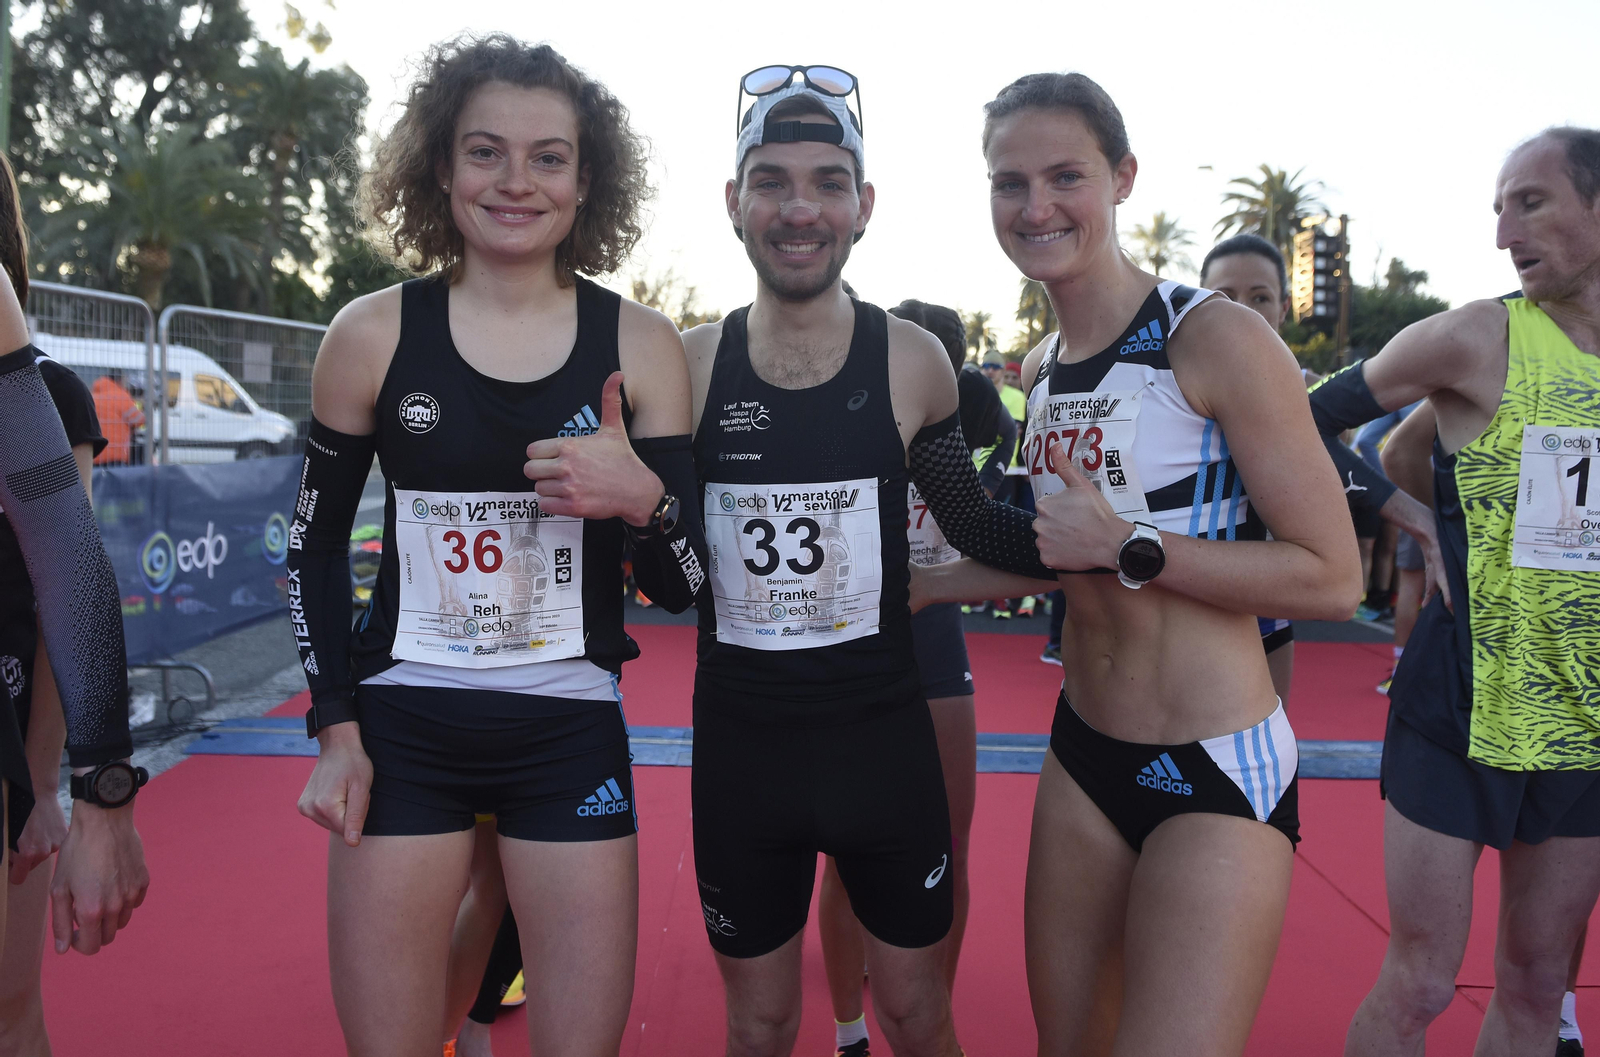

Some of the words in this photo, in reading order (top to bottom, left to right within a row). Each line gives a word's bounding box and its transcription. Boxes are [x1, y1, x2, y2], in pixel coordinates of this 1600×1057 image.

[1120, 338, 1164, 355] adidas
[1057, 397, 1109, 411] maratón
[720, 417, 750, 426] Marathon
[1069, 407, 1107, 420] sevilla
[724, 424, 752, 432] Hamburg
[1564, 435, 1591, 452] edp
[296, 456, 310, 512] MARATHON
[300, 490, 310, 518] TEAM
[737, 493, 767, 512] edp
[804, 499, 848, 511] sevilla
[788, 489, 848, 502] maratón
[306, 488, 319, 522] BERLIN
[431, 500, 460, 520] edp
[500, 508, 548, 520] sevilla
[176, 521, 228, 579] edp
[442, 529, 504, 574] 36
[670, 541, 682, 558] adidas
[742, 516, 825, 576] 33
[1562, 552, 1582, 560] HOKA
[678, 546, 706, 596] TERREX
[767, 578, 803, 586] Benjamin
[468, 592, 488, 600] Alina
[770, 588, 817, 600] Franke
[287, 566, 312, 652] TERREX
[474, 604, 500, 617] Reh
[788, 602, 818, 618] edp
[482, 616, 512, 635] edp
[756, 628, 776, 636] HOKA
[447, 644, 469, 653] HOKA
[309, 650, 320, 676] adidas
[1136, 774, 1194, 796] adidas
[576, 800, 629, 817] adidas
